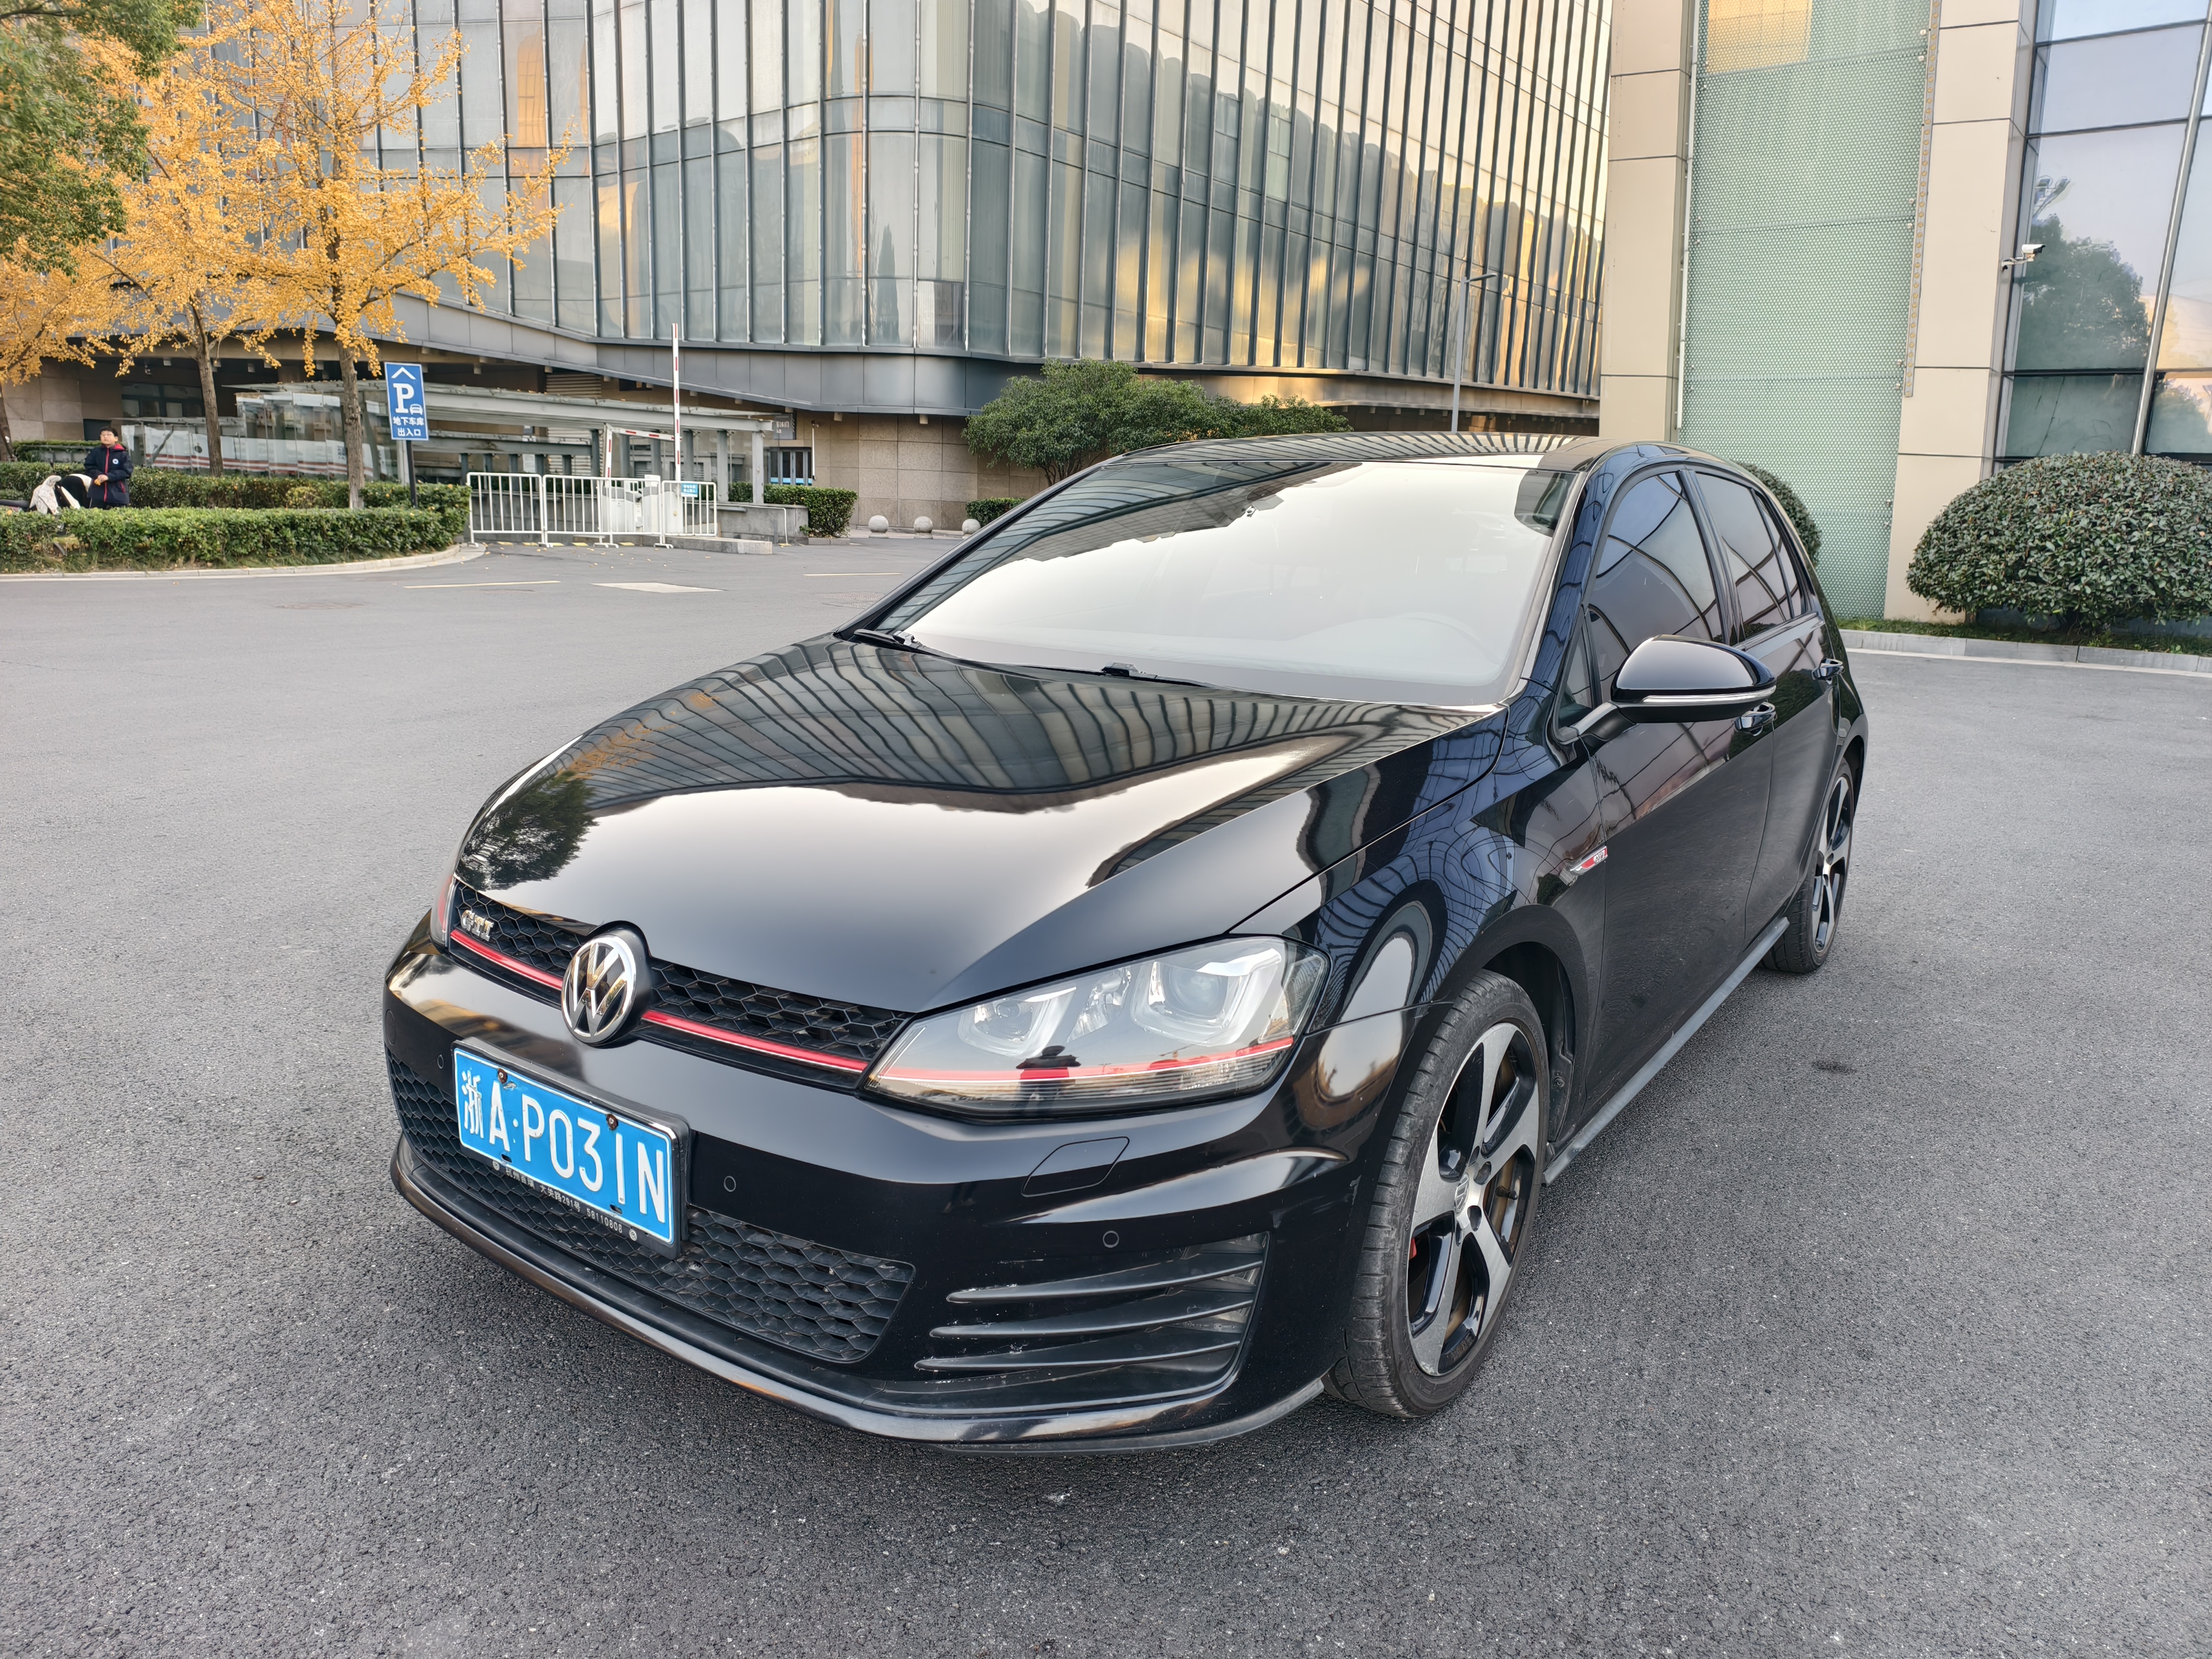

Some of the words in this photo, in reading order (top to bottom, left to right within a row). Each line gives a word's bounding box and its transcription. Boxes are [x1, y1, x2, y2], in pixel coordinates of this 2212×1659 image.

[393, 383, 414, 413] P
[393, 416, 424, 426] 地下车库
[397, 427, 421, 437] 出入口
[461, 910, 494, 942] GTI
[586, 1208, 623, 1233] 58110808
